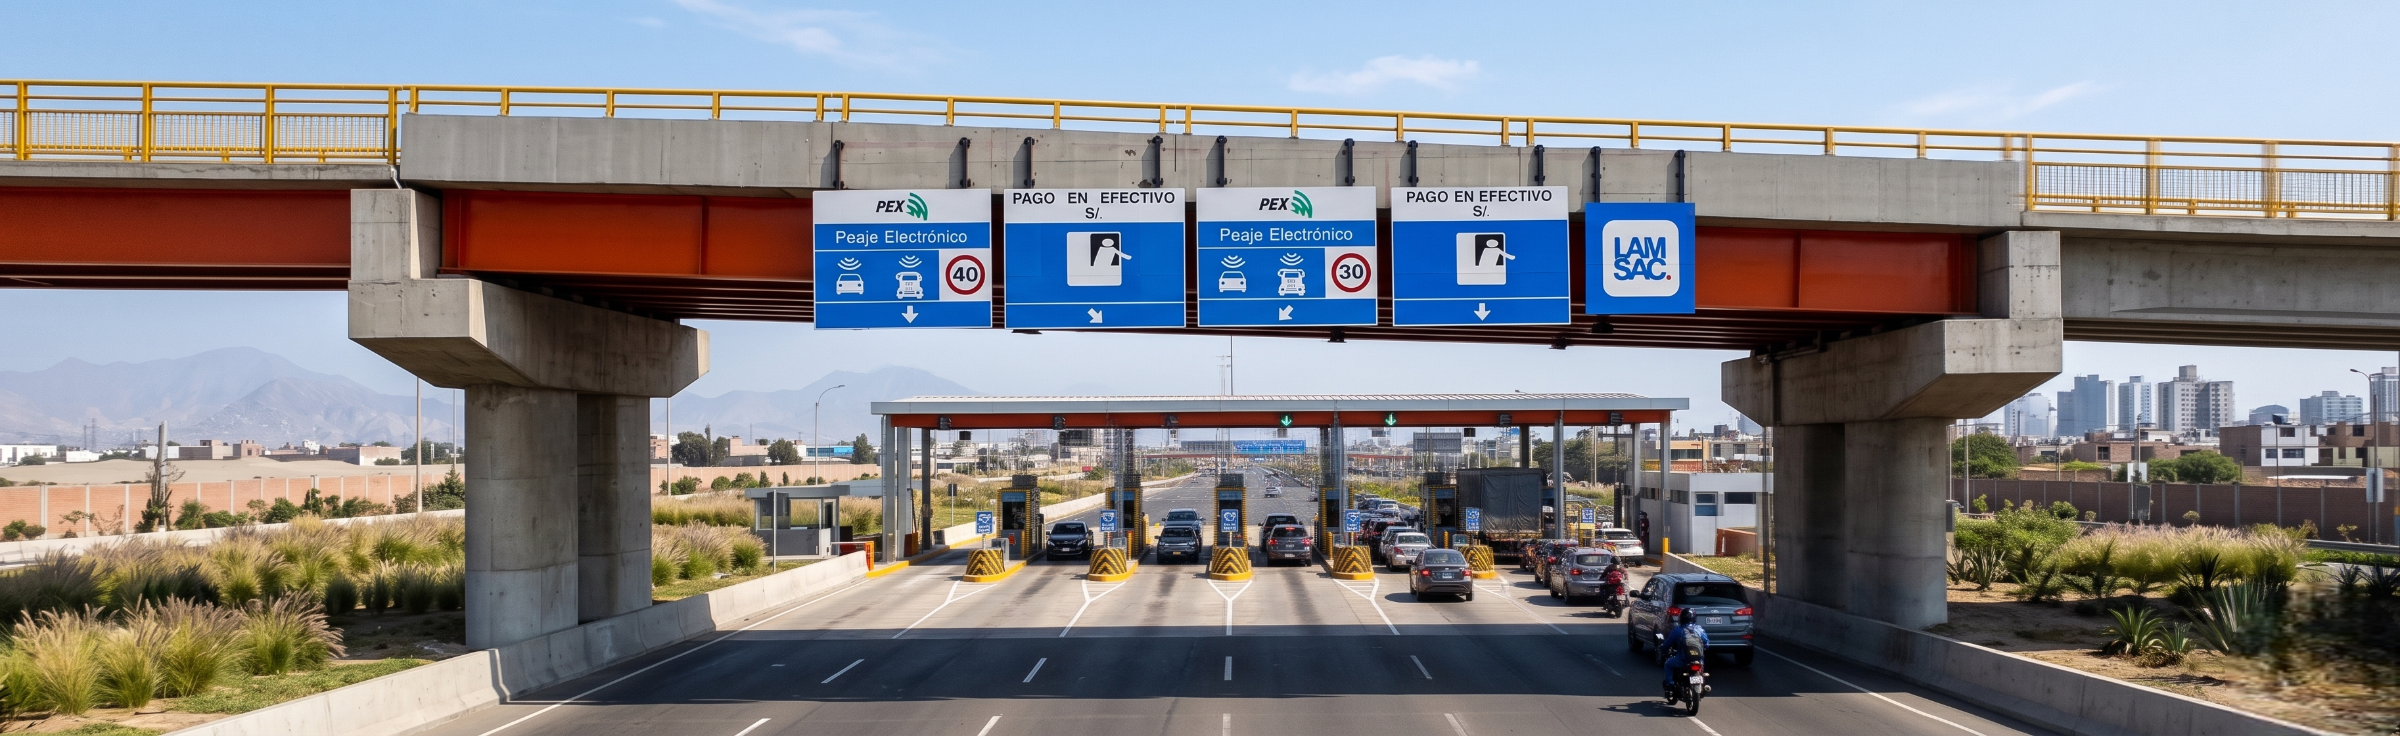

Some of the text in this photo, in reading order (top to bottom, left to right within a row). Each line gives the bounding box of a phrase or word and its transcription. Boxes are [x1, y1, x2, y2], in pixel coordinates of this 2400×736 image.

[1013, 191, 1175, 205] PAGO EN EFECTIVO
[1406, 189, 1552, 203] PAGO EN EFECTIVO
[876, 199, 906, 213] PEX
[1259, 197, 1290, 211] PEX
[1085, 207, 1103, 220] S/.
[1472, 205, 1490, 218] S/.
[835, 229, 968, 247] Peaje Electrónico
[1220, 227, 1353, 245] Peaje Electrónico
[1614, 236, 1667, 260] LAM
[952, 266, 978, 282] 40
[1339, 264, 1364, 280] 30
